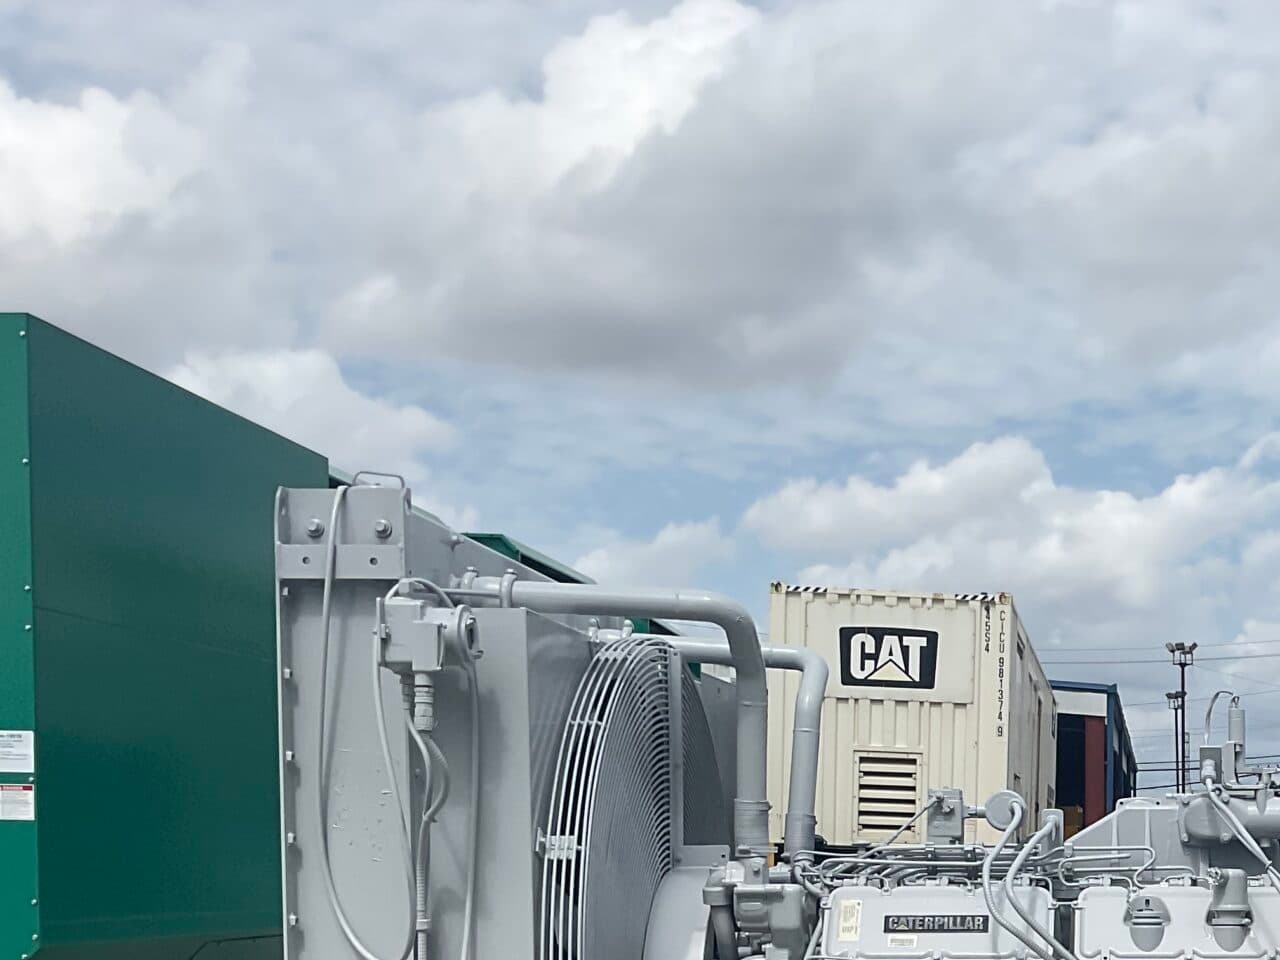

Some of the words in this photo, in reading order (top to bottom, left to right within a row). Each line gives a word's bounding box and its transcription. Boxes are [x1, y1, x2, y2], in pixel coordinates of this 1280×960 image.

[849, 632, 928, 683] CAT
[997, 656, 1005, 722] 981374
[997, 726, 1003, 737] 9
[888, 916, 984, 930] CATERPILLAR
